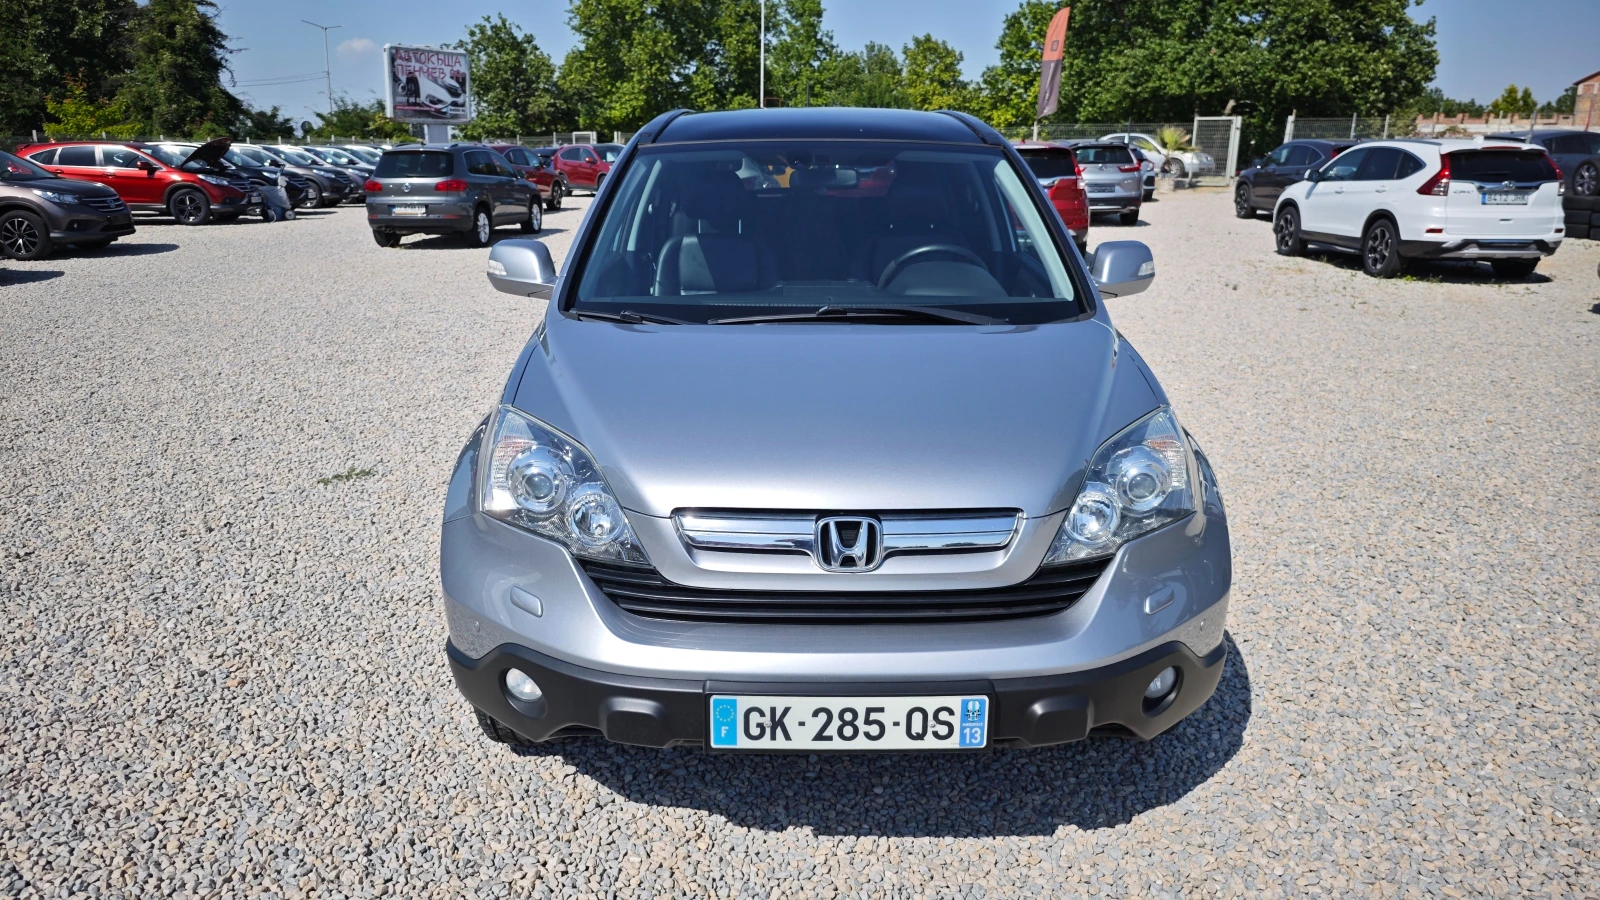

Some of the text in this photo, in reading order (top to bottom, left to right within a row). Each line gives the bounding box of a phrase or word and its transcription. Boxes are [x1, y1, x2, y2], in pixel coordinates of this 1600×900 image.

[395, 49, 462, 69] АВТОКЪЩА
[395, 64, 447, 80] ПЕНЧЕВ
[1487, 193, 1508, 202] 8412
[721, 726, 729, 738] F
[963, 727, 981, 744] 13
